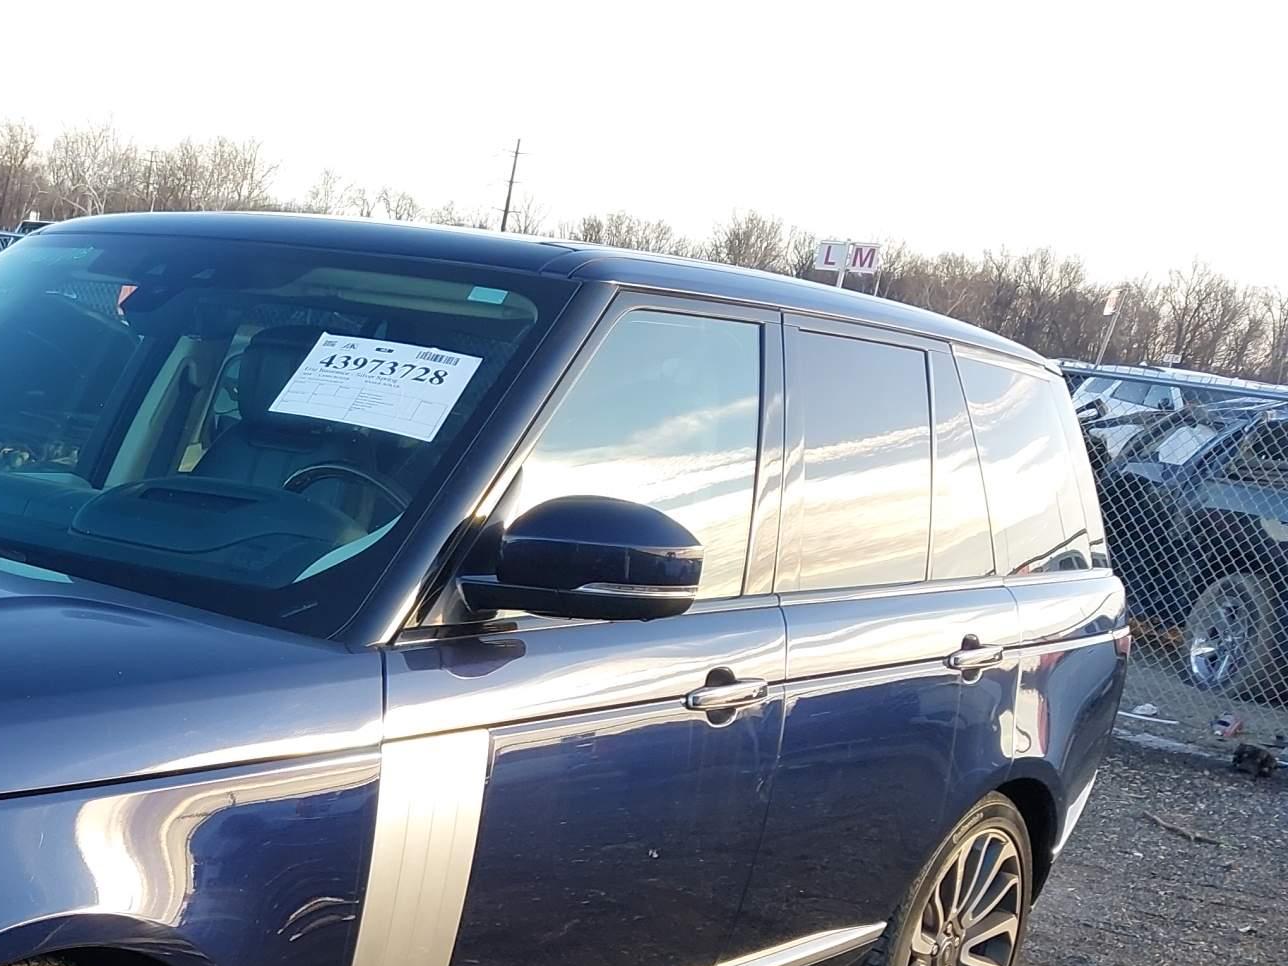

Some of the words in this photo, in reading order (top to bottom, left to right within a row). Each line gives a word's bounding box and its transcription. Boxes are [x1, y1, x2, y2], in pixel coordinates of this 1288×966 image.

[824, 245, 836, 266] L
[852, 247, 876, 268] M
[320, 353, 449, 386] 43973728
